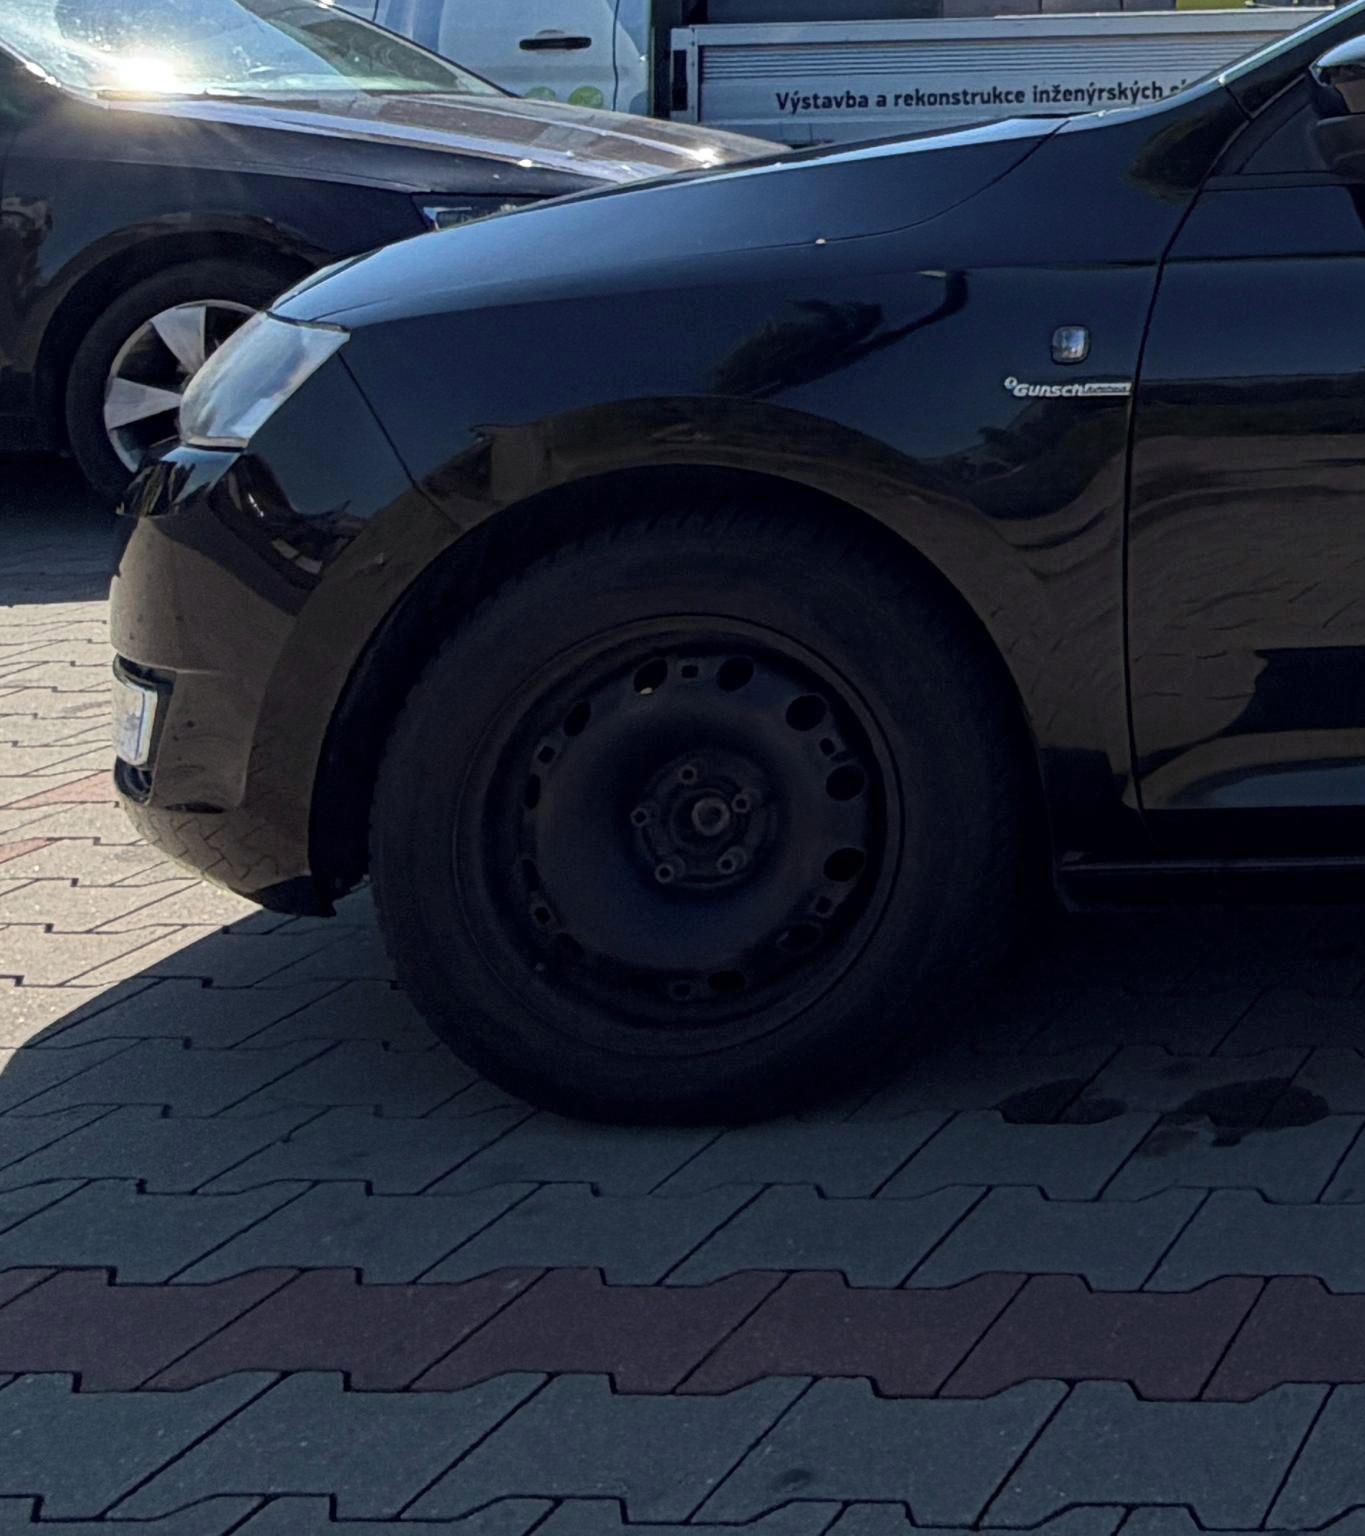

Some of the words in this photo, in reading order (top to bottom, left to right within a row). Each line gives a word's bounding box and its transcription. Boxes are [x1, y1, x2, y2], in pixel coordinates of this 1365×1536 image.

[776, 92, 869, 115] Výstavba
[875, 96, 887, 109] a
[893, 86, 1026, 107] rekonstrukce
[1032, 81, 1164, 105] inženýrských
